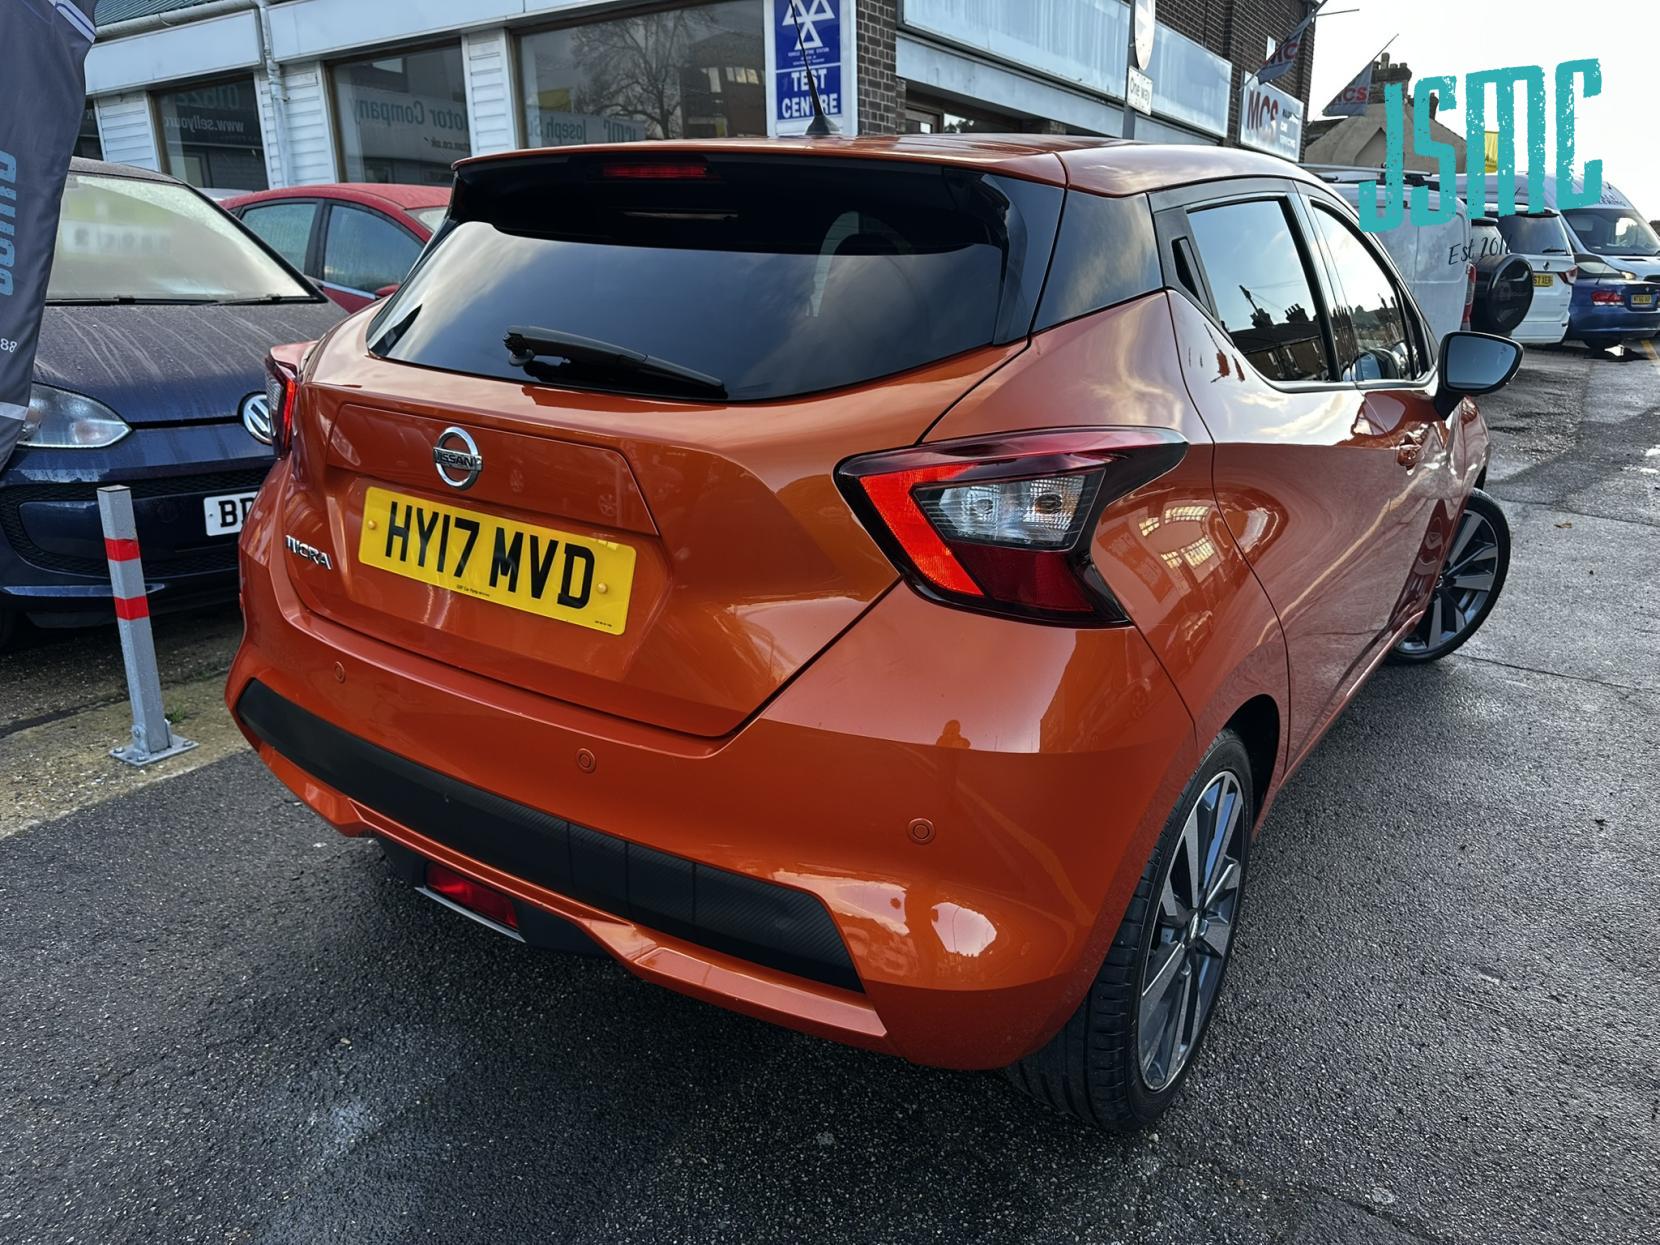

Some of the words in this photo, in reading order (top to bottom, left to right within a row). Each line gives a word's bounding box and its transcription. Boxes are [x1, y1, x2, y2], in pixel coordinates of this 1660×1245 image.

[782, 93, 838, 118] CENRE
[1247, 89, 1279, 138] MCS
[435, 449, 475, 467] NISSAN
[385, 501, 481, 577] HY17
[488, 526, 596, 610] MVD
